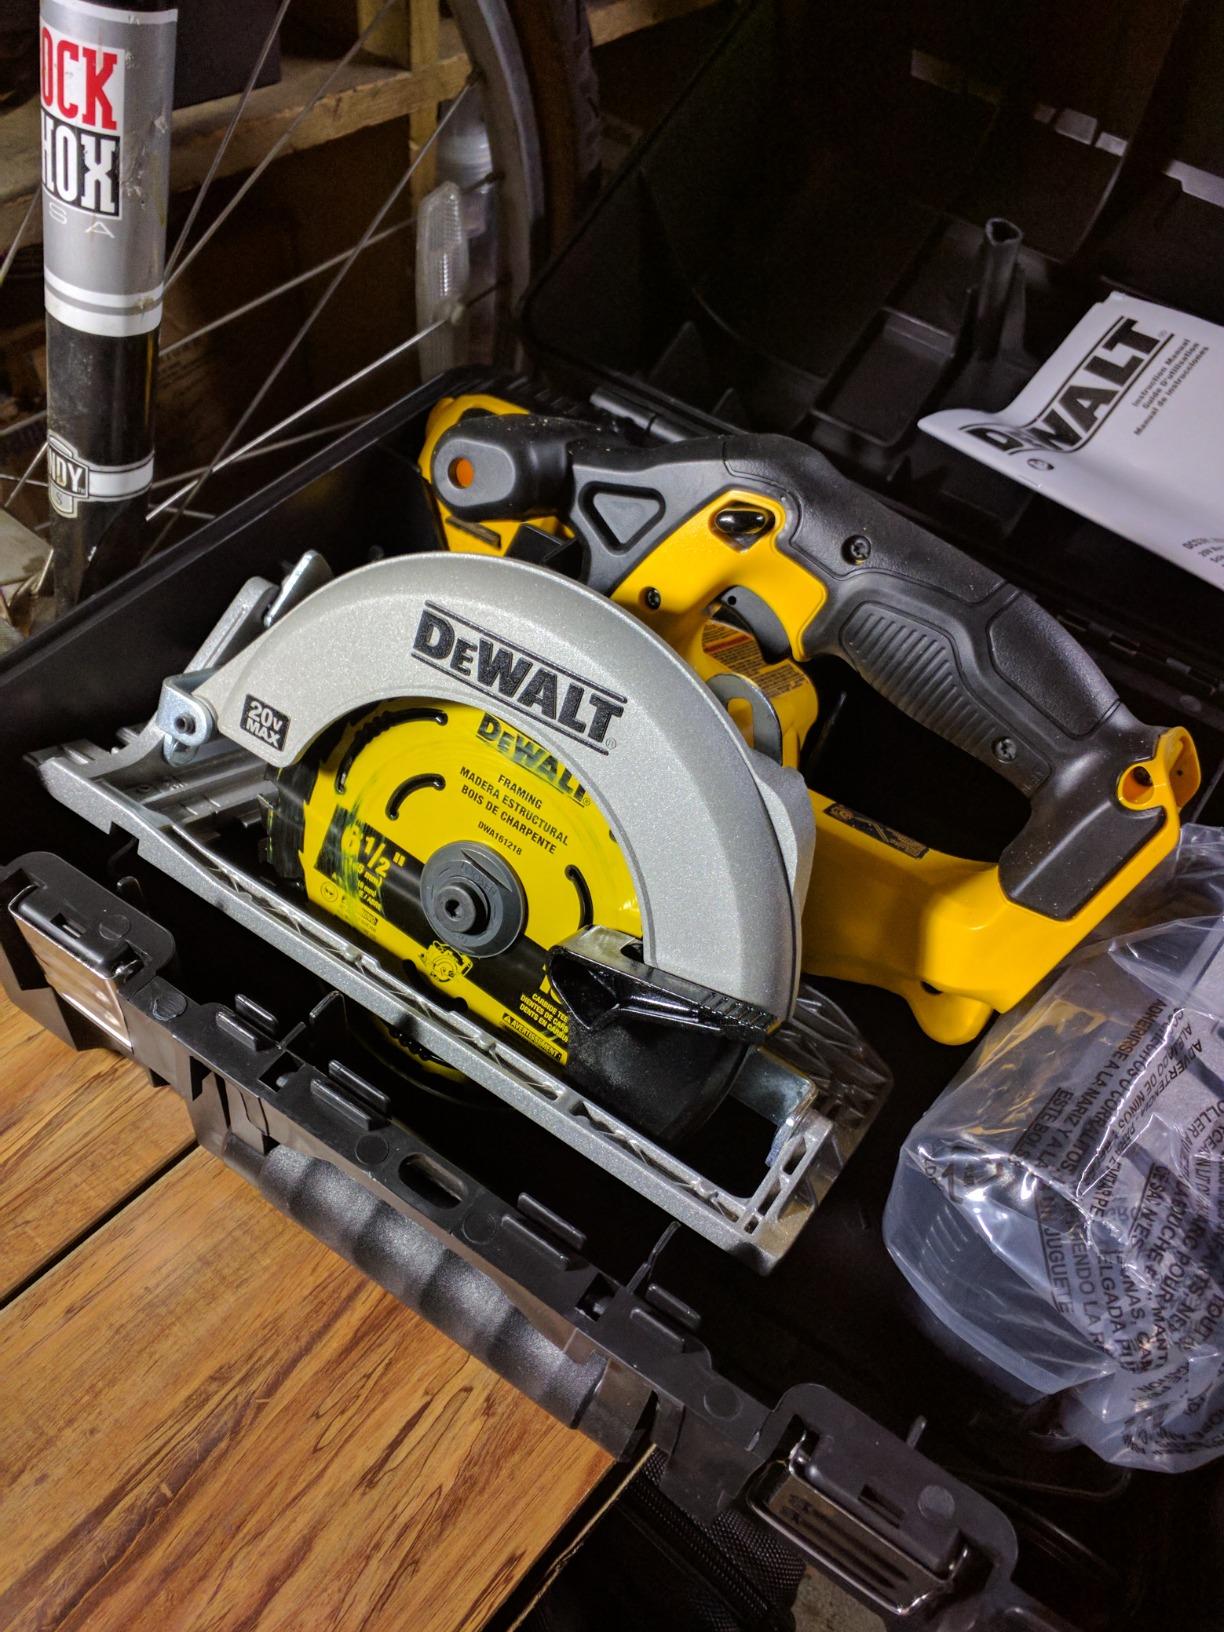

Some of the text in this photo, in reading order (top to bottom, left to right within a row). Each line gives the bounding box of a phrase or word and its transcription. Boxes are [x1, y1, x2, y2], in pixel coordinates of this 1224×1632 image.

[1131, 338, 1191, 408] Instruction Manual
[1133, 406, 1160, 436] Manual
[1156, 396, 1168, 407] de
[1142, 387, 1163, 410] Guide
[245, 717, 281, 749] MAX
[459, 765, 569, 847] MADERA ESTRUCTURAL
[497, 774, 543, 810] FRAMING
[460, 783, 557, 855] BOIS DE CHARPENTE
[477, 820, 523, 856] DWA161218
[519, 993, 545, 1018] DIENTES
[543, 1011, 555, 1023] DE
[519, 1002, 539, 1022] DENTS
[538, 1016, 549, 1028] EN
[531, 992, 558, 1016] CARBIDE
[1112, 998, 1168, 1062] ADHERIRSE
[1092, 1069, 1114, 1090] LA
[1038, 1088, 1074, 1126] ESTE
[1062, 1087, 1101, 1128] NARIZ
[1048, 1137, 1063, 1151] A
[1055, 1126, 1071, 1139] Y
[1042, 1227, 1075, 1314] JUGUETE
[1099, 1257, 1128, 1334] ELGADA
